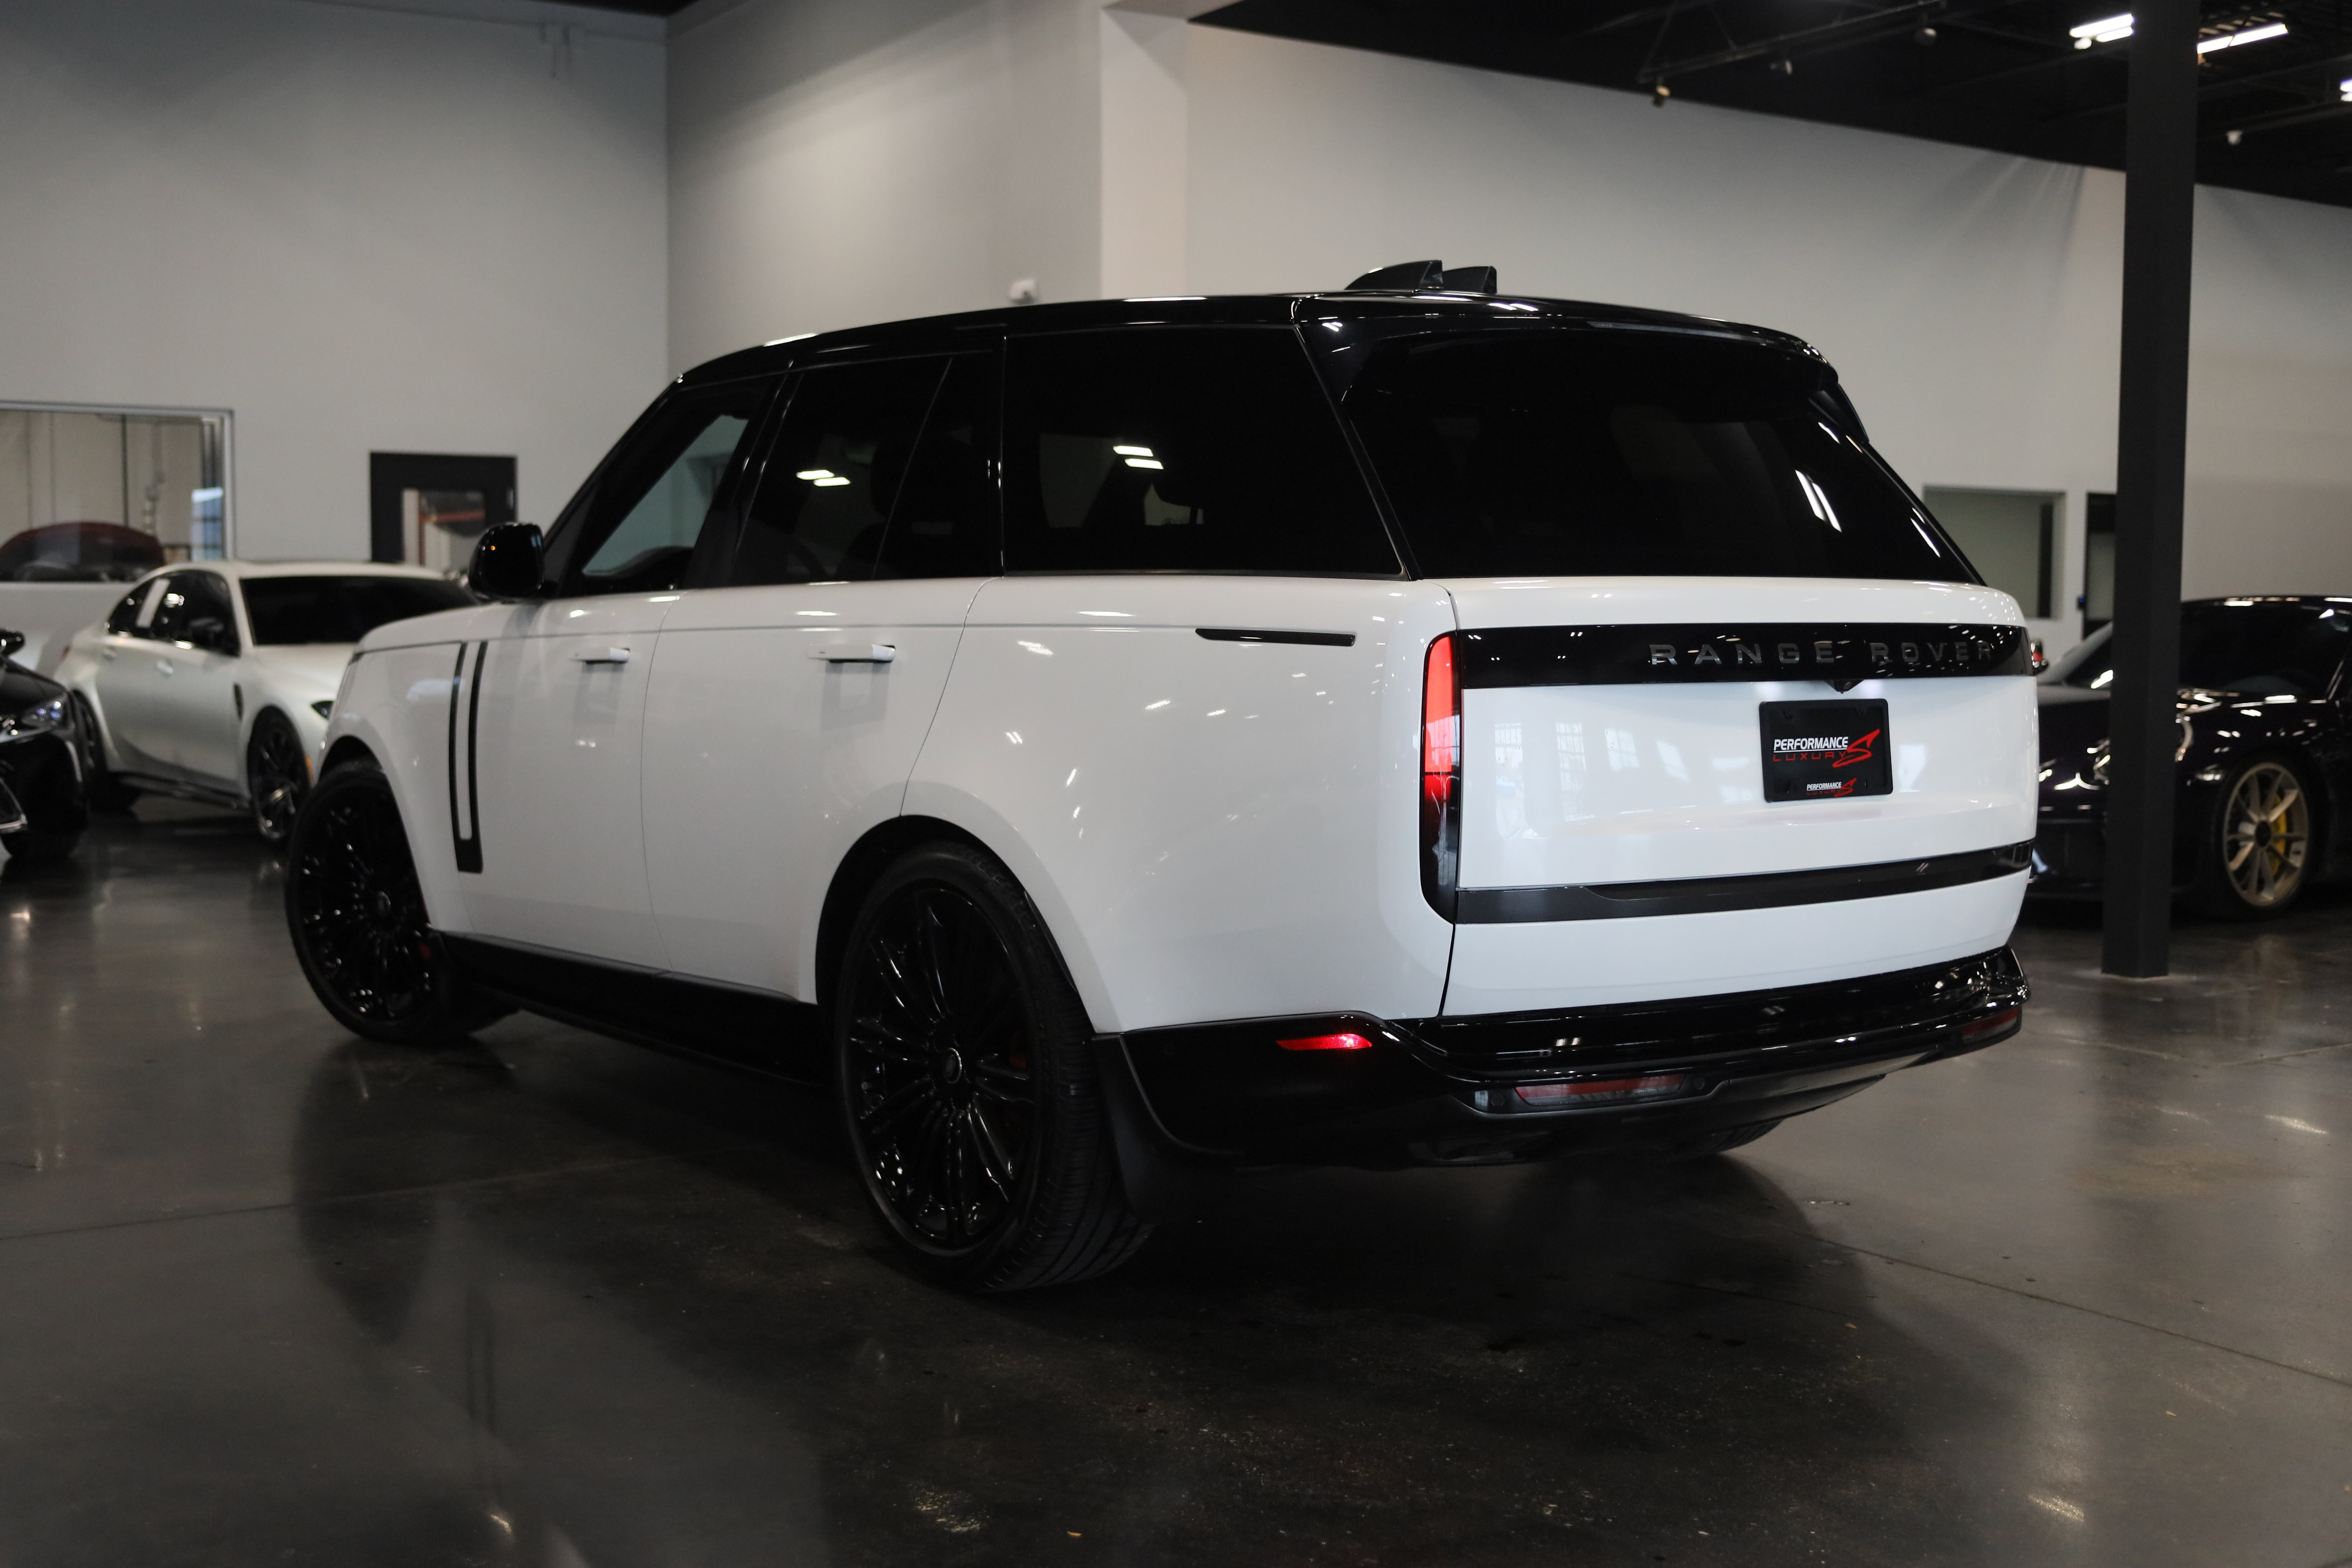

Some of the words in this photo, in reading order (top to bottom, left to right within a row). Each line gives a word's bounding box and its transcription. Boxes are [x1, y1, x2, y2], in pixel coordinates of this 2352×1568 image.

[1648, 642, 1834, 665] RANGE
[1869, 641, 1991, 662] ROVER
[1773, 736, 1849, 751] PERFORMANCE
[1773, 751, 1848, 762] LUXURY
[1806, 781, 1842, 791] PERFORMANCE
